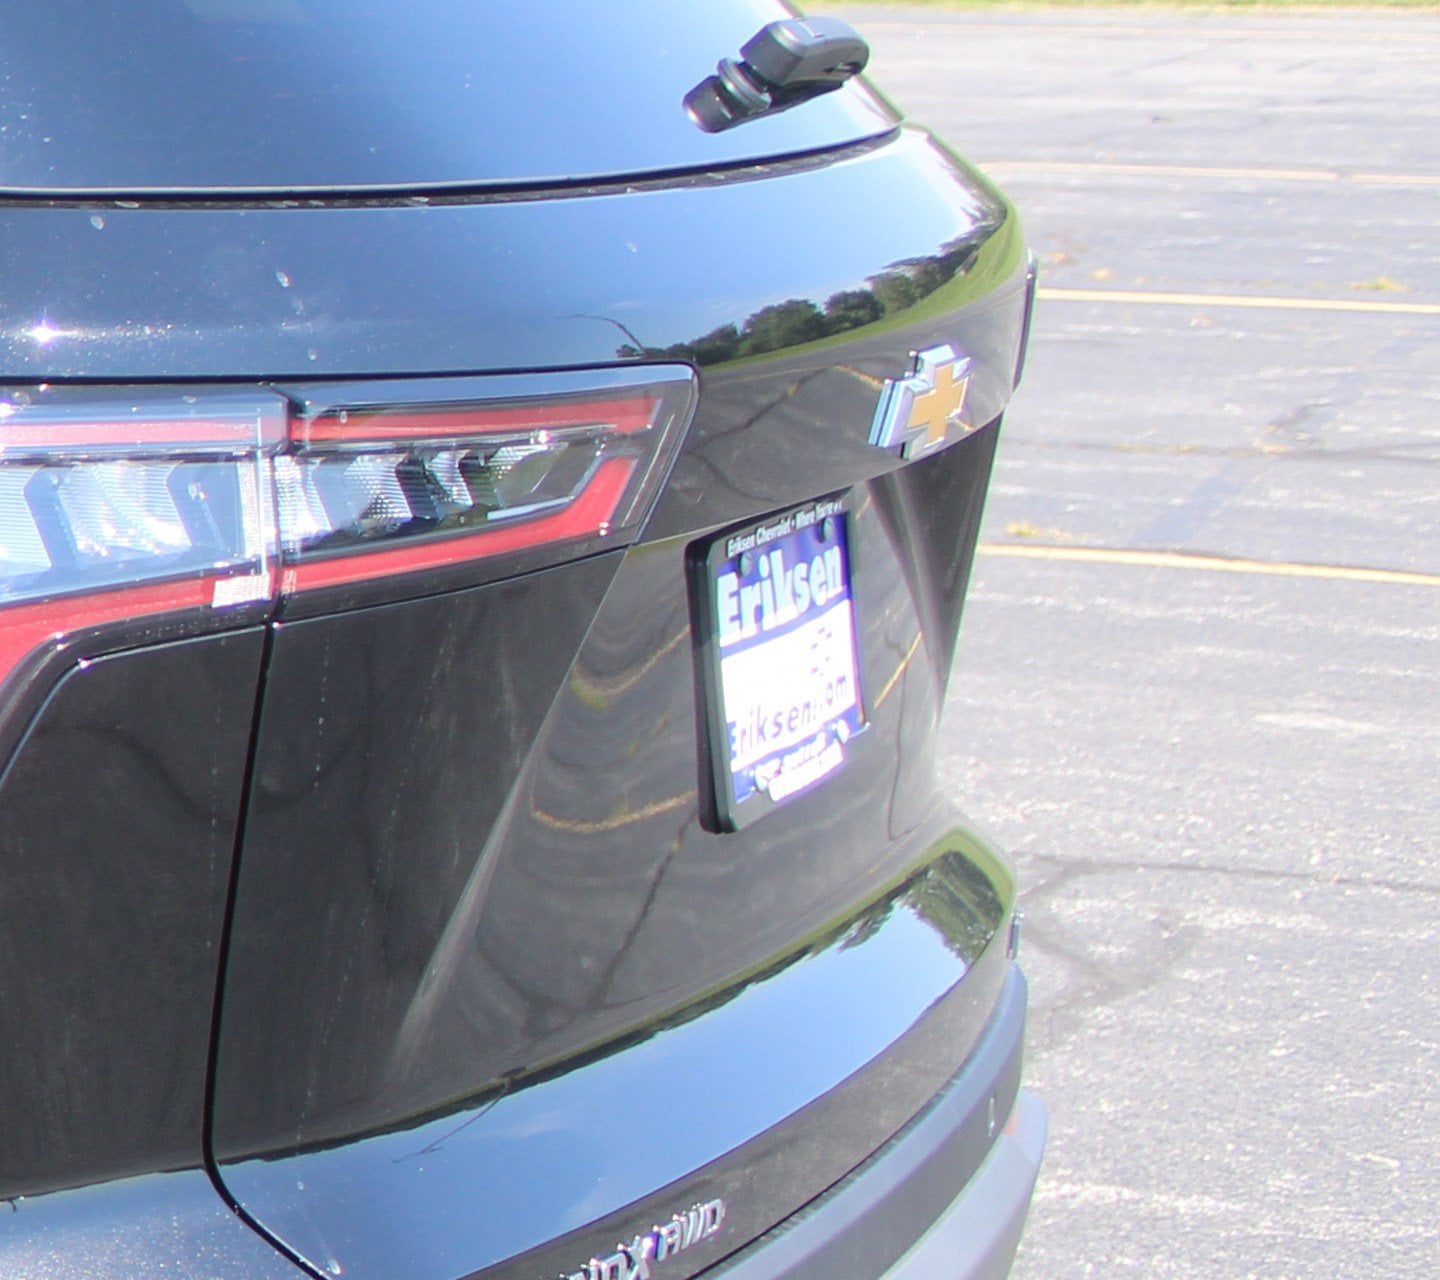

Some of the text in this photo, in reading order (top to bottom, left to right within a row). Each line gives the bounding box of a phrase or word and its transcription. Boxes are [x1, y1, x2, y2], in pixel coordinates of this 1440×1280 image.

[726, 533, 756, 558] Eriksen
[717, 545, 845, 647] Eriksen
[653, 1198, 726, 1262] AWD
